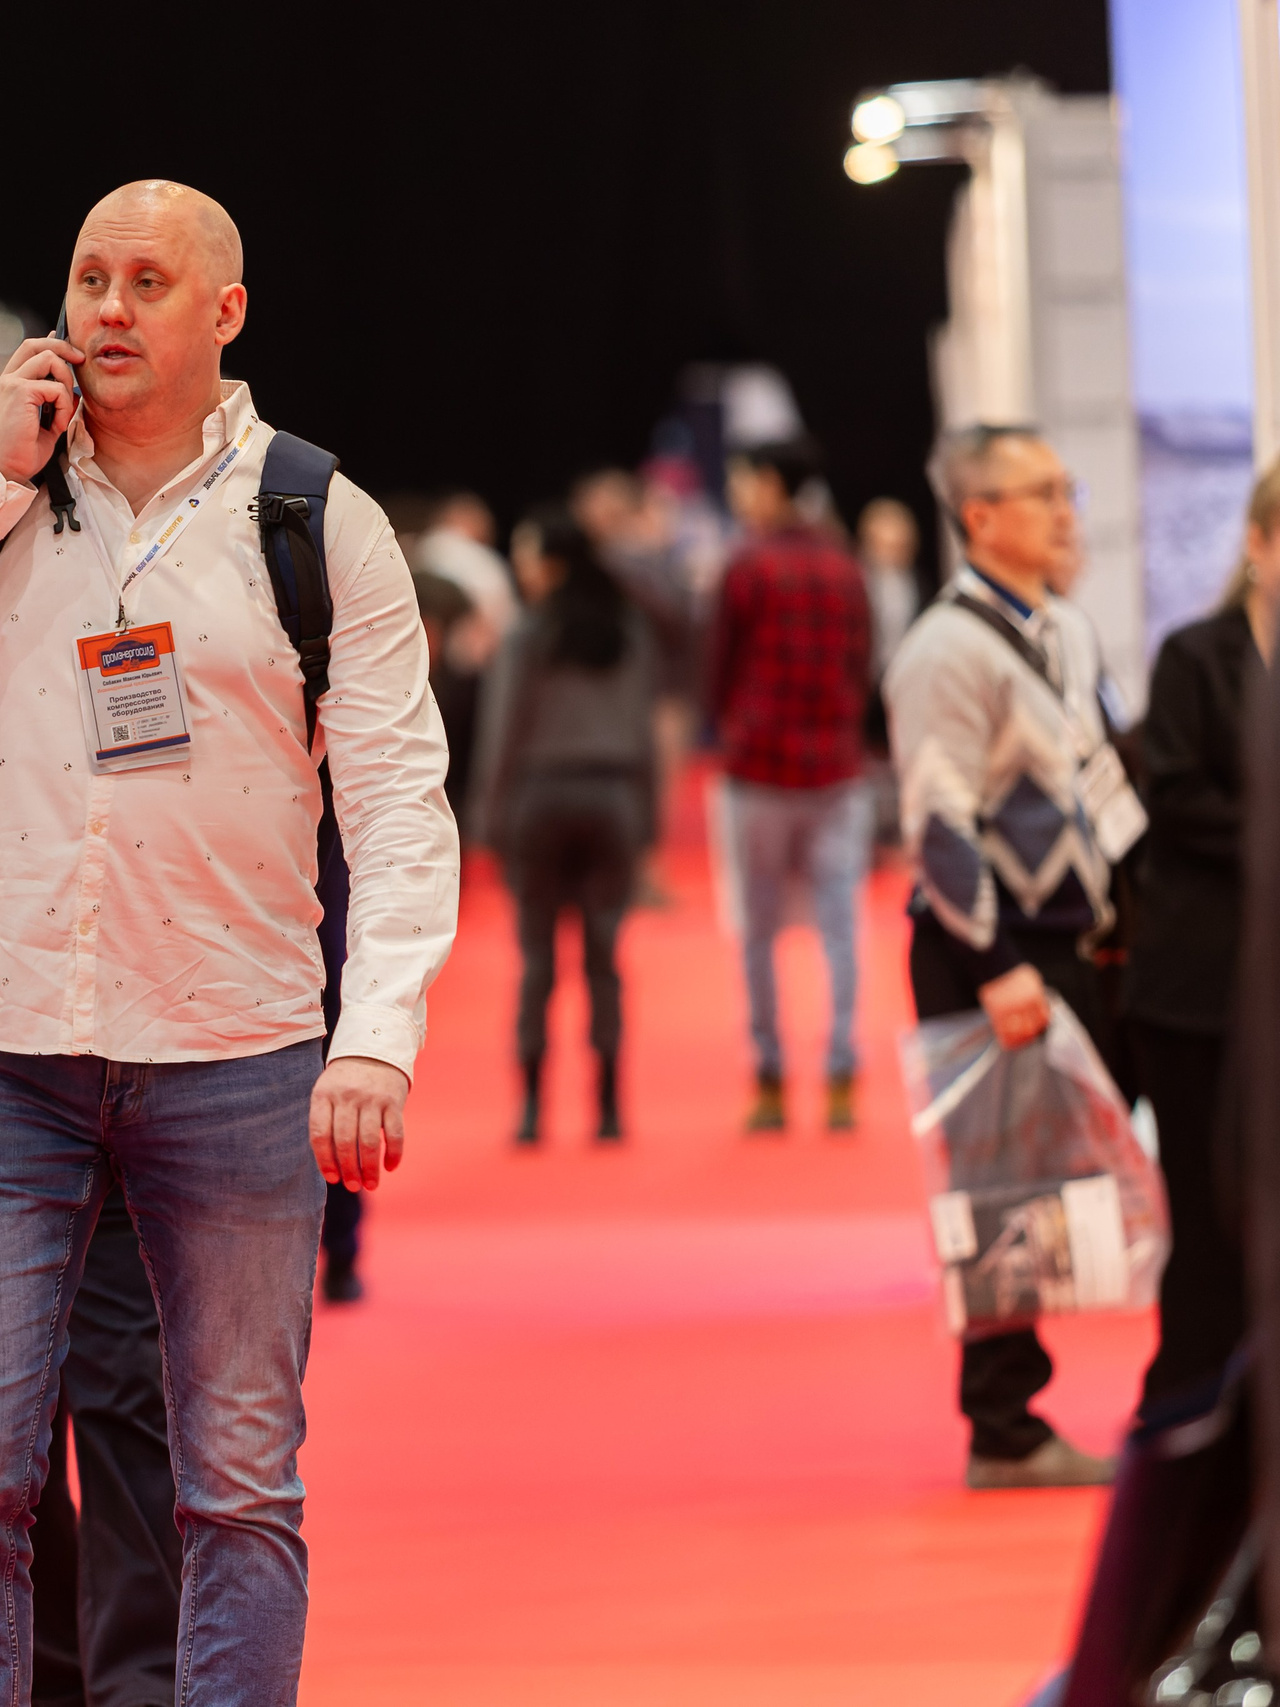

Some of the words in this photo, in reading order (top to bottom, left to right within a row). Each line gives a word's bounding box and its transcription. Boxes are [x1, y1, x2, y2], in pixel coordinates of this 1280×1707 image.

[102, 645, 155, 667] промэнергосила
[107, 695, 167, 711] компрессорного
[109, 688, 162, 703] Производство
[111, 703, 165, 718] оборудования
